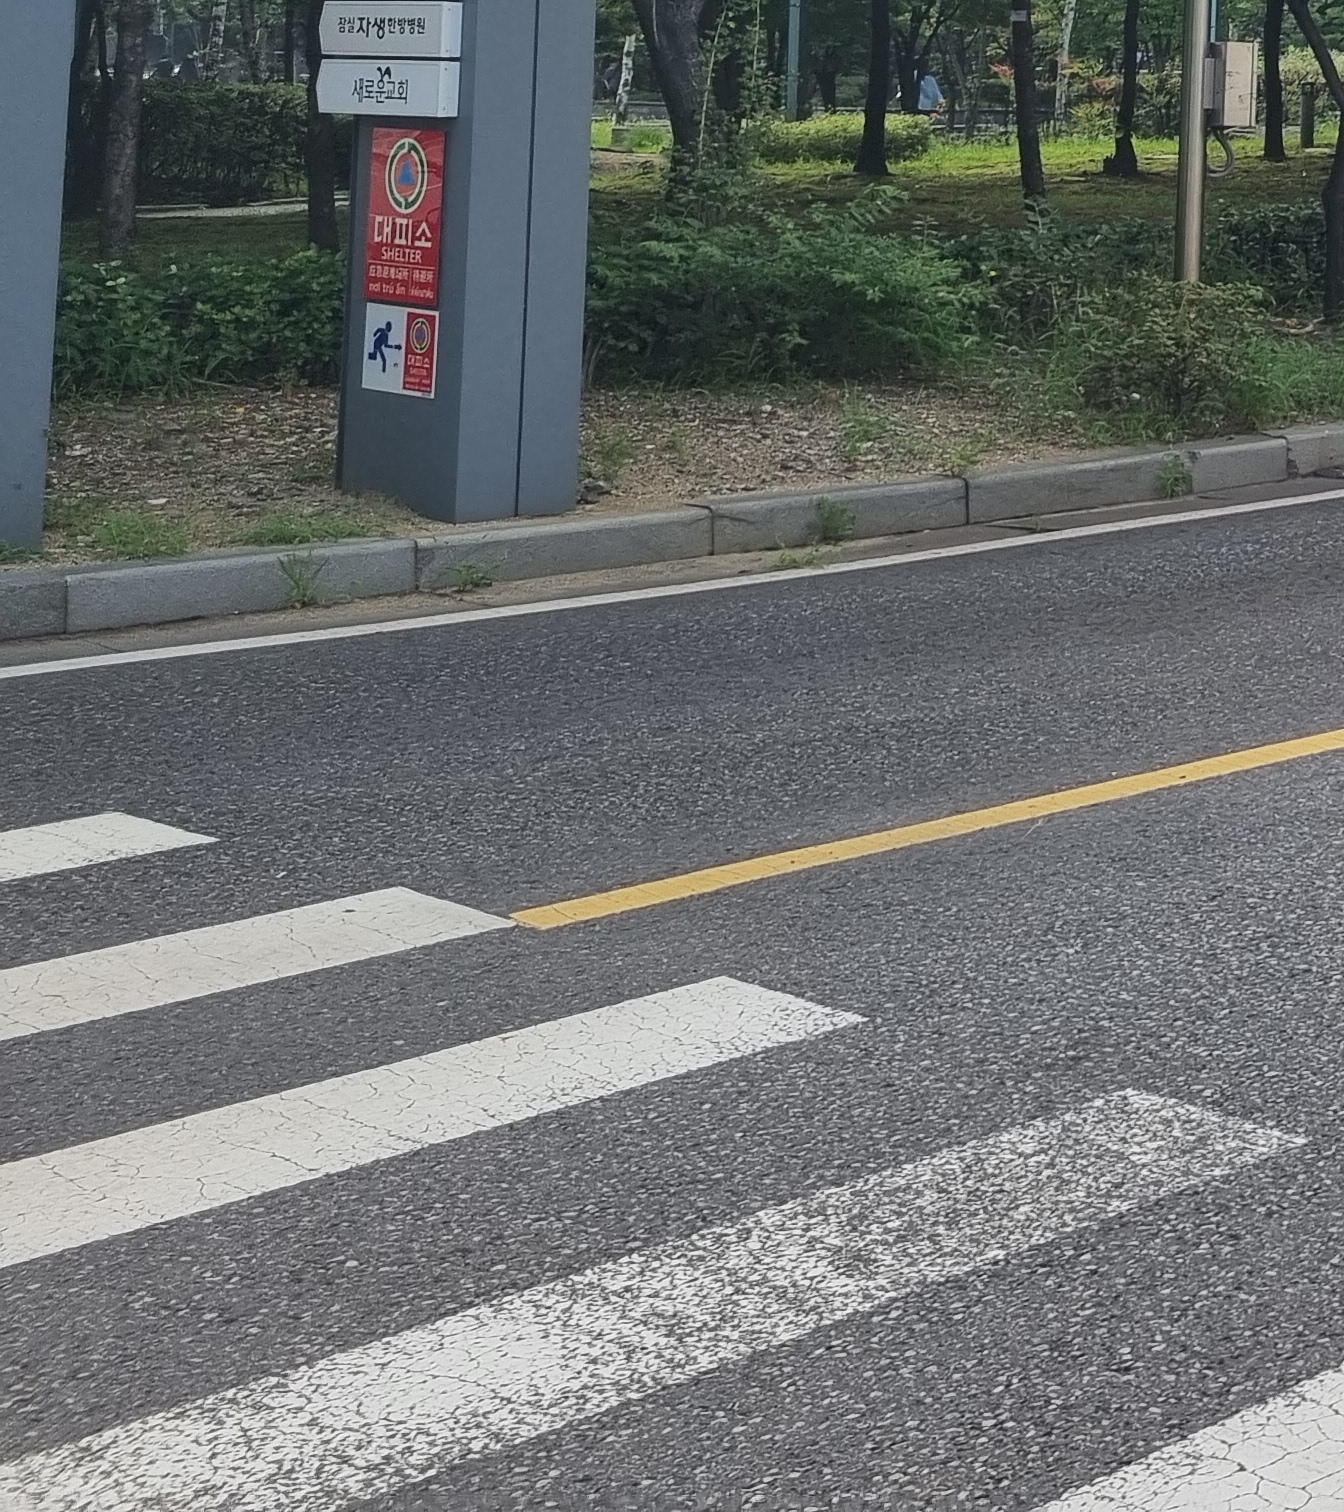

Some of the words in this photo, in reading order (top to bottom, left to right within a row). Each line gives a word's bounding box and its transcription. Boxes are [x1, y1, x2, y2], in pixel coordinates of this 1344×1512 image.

[337, 17, 355, 34] 잠실
[352, 68, 409, 104] 새로운교회
[374, 215, 432, 248] 대피소
[381, 246, 422, 263] SHELTER
